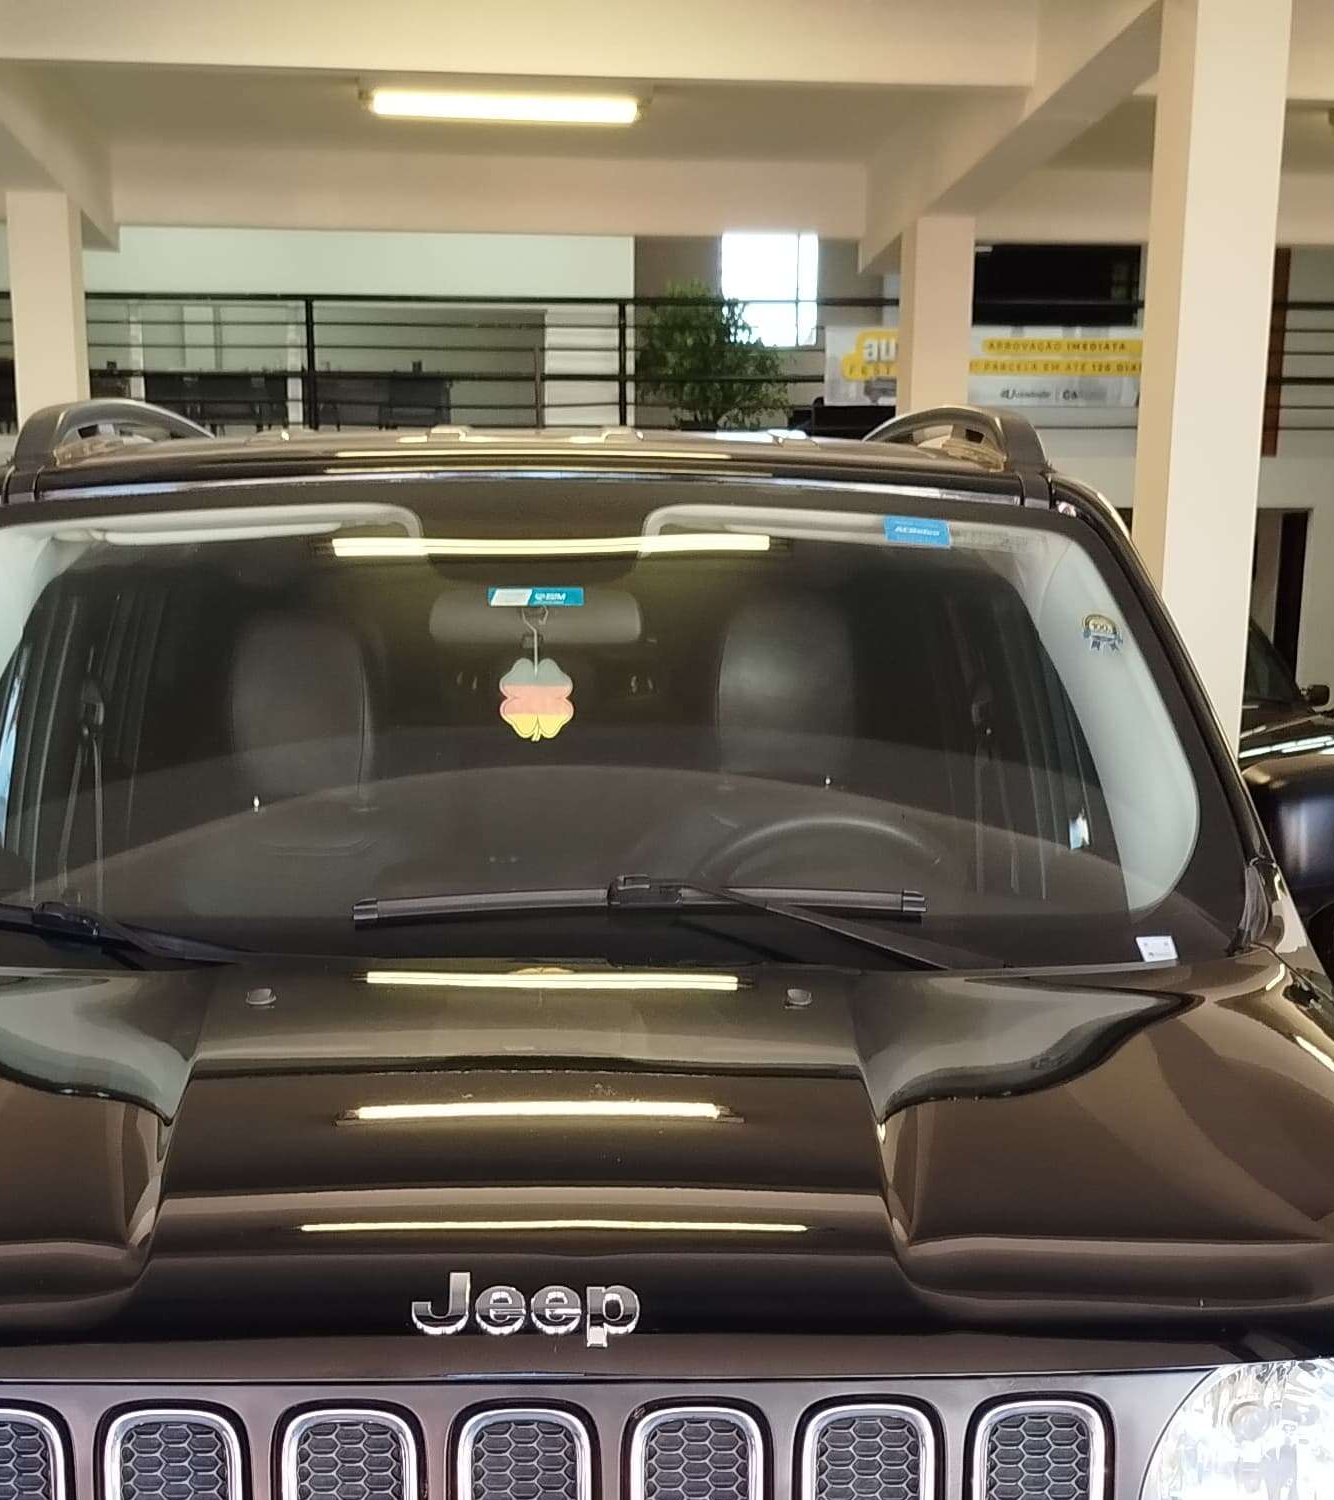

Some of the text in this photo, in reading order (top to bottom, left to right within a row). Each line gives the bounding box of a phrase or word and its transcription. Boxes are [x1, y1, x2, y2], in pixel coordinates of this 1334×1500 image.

[1066, 342, 1126, 351] IMEDIATA
[984, 362, 1037, 373] PARCELA
[1043, 363, 1060, 372] EM
[411, 1272, 640, 1347] Jeep
